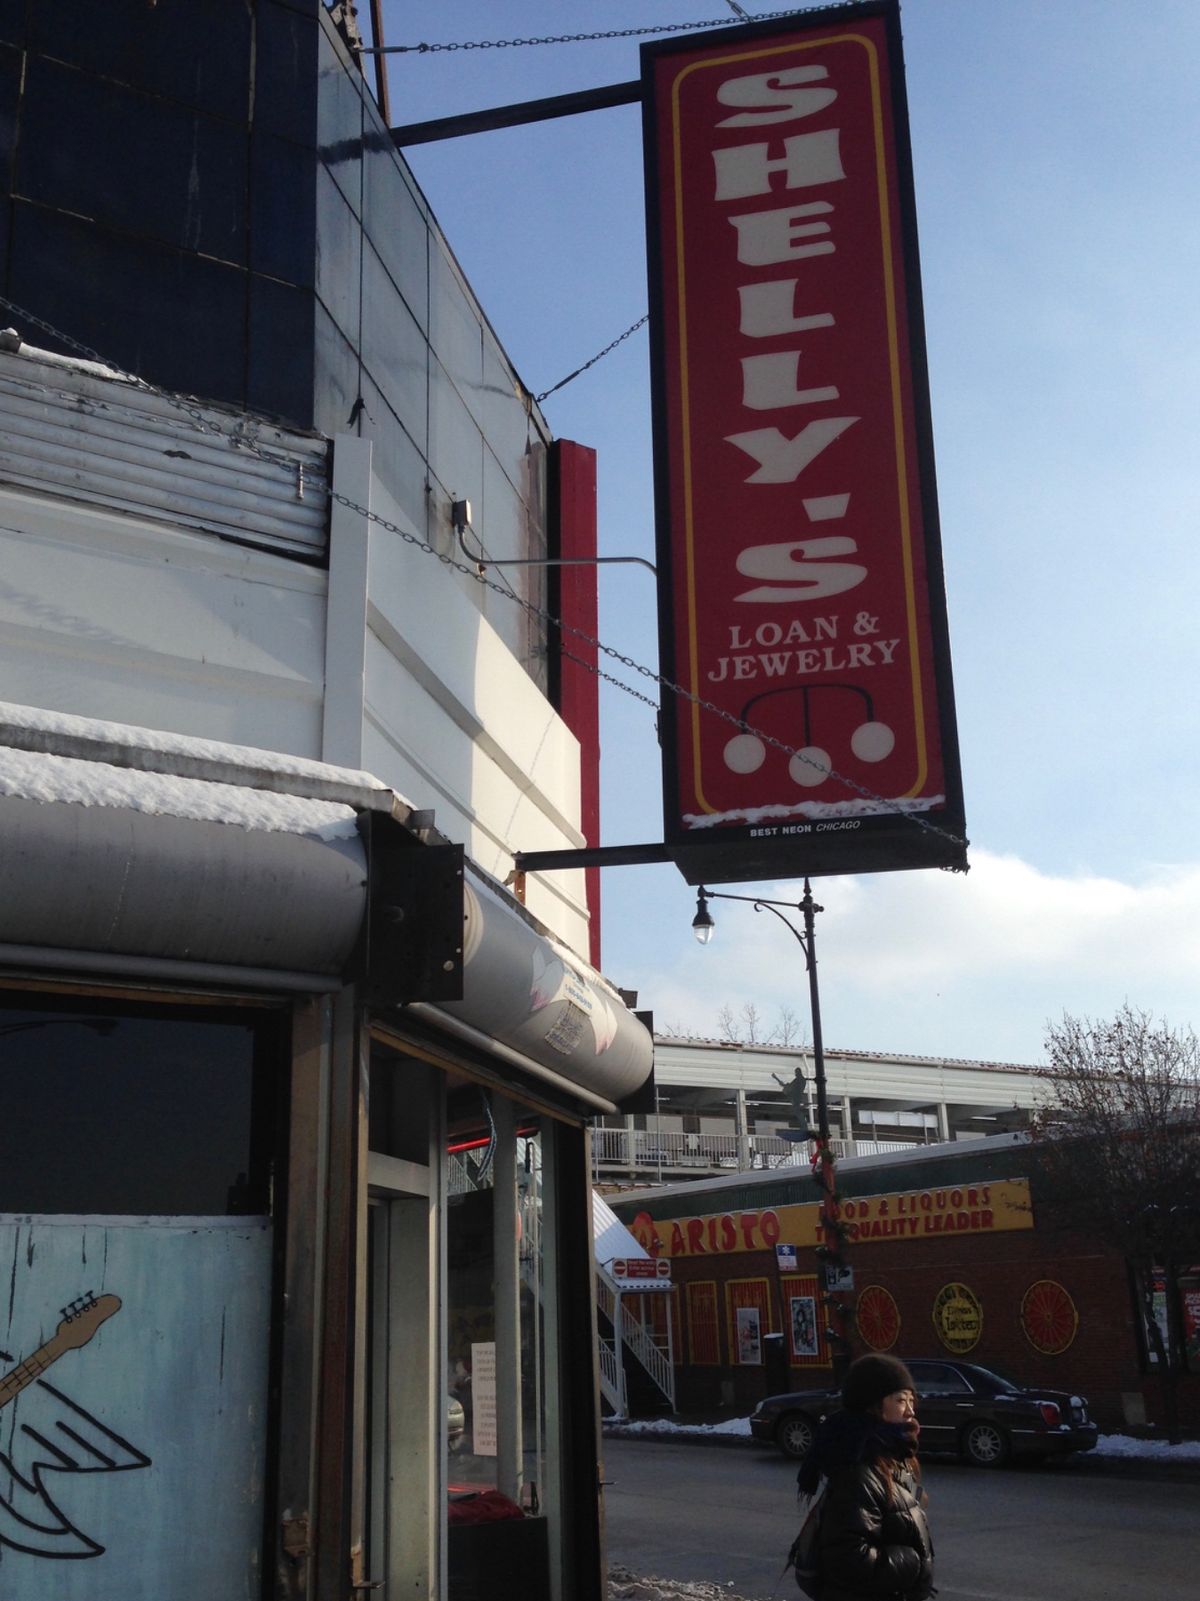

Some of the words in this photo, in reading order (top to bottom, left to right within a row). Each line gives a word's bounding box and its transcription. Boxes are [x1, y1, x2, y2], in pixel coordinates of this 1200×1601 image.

[711, 64, 868, 603] SHELLY'S
[729, 615, 839, 649] LOAN
[853, 611, 880, 636] &
[708, 638, 900, 682] JEWELRY
[750, 827, 778, 838] BEST
[782, 825, 812, 835] NEON
[816, 820, 861, 832] CHICAGO
[898, 1186, 992, 1214] LIQUORS
[670, 1208, 780, 1256] ARISTO
[850, 1215, 920, 1241] QUALITY
[924, 1207, 994, 1233] LEADER
